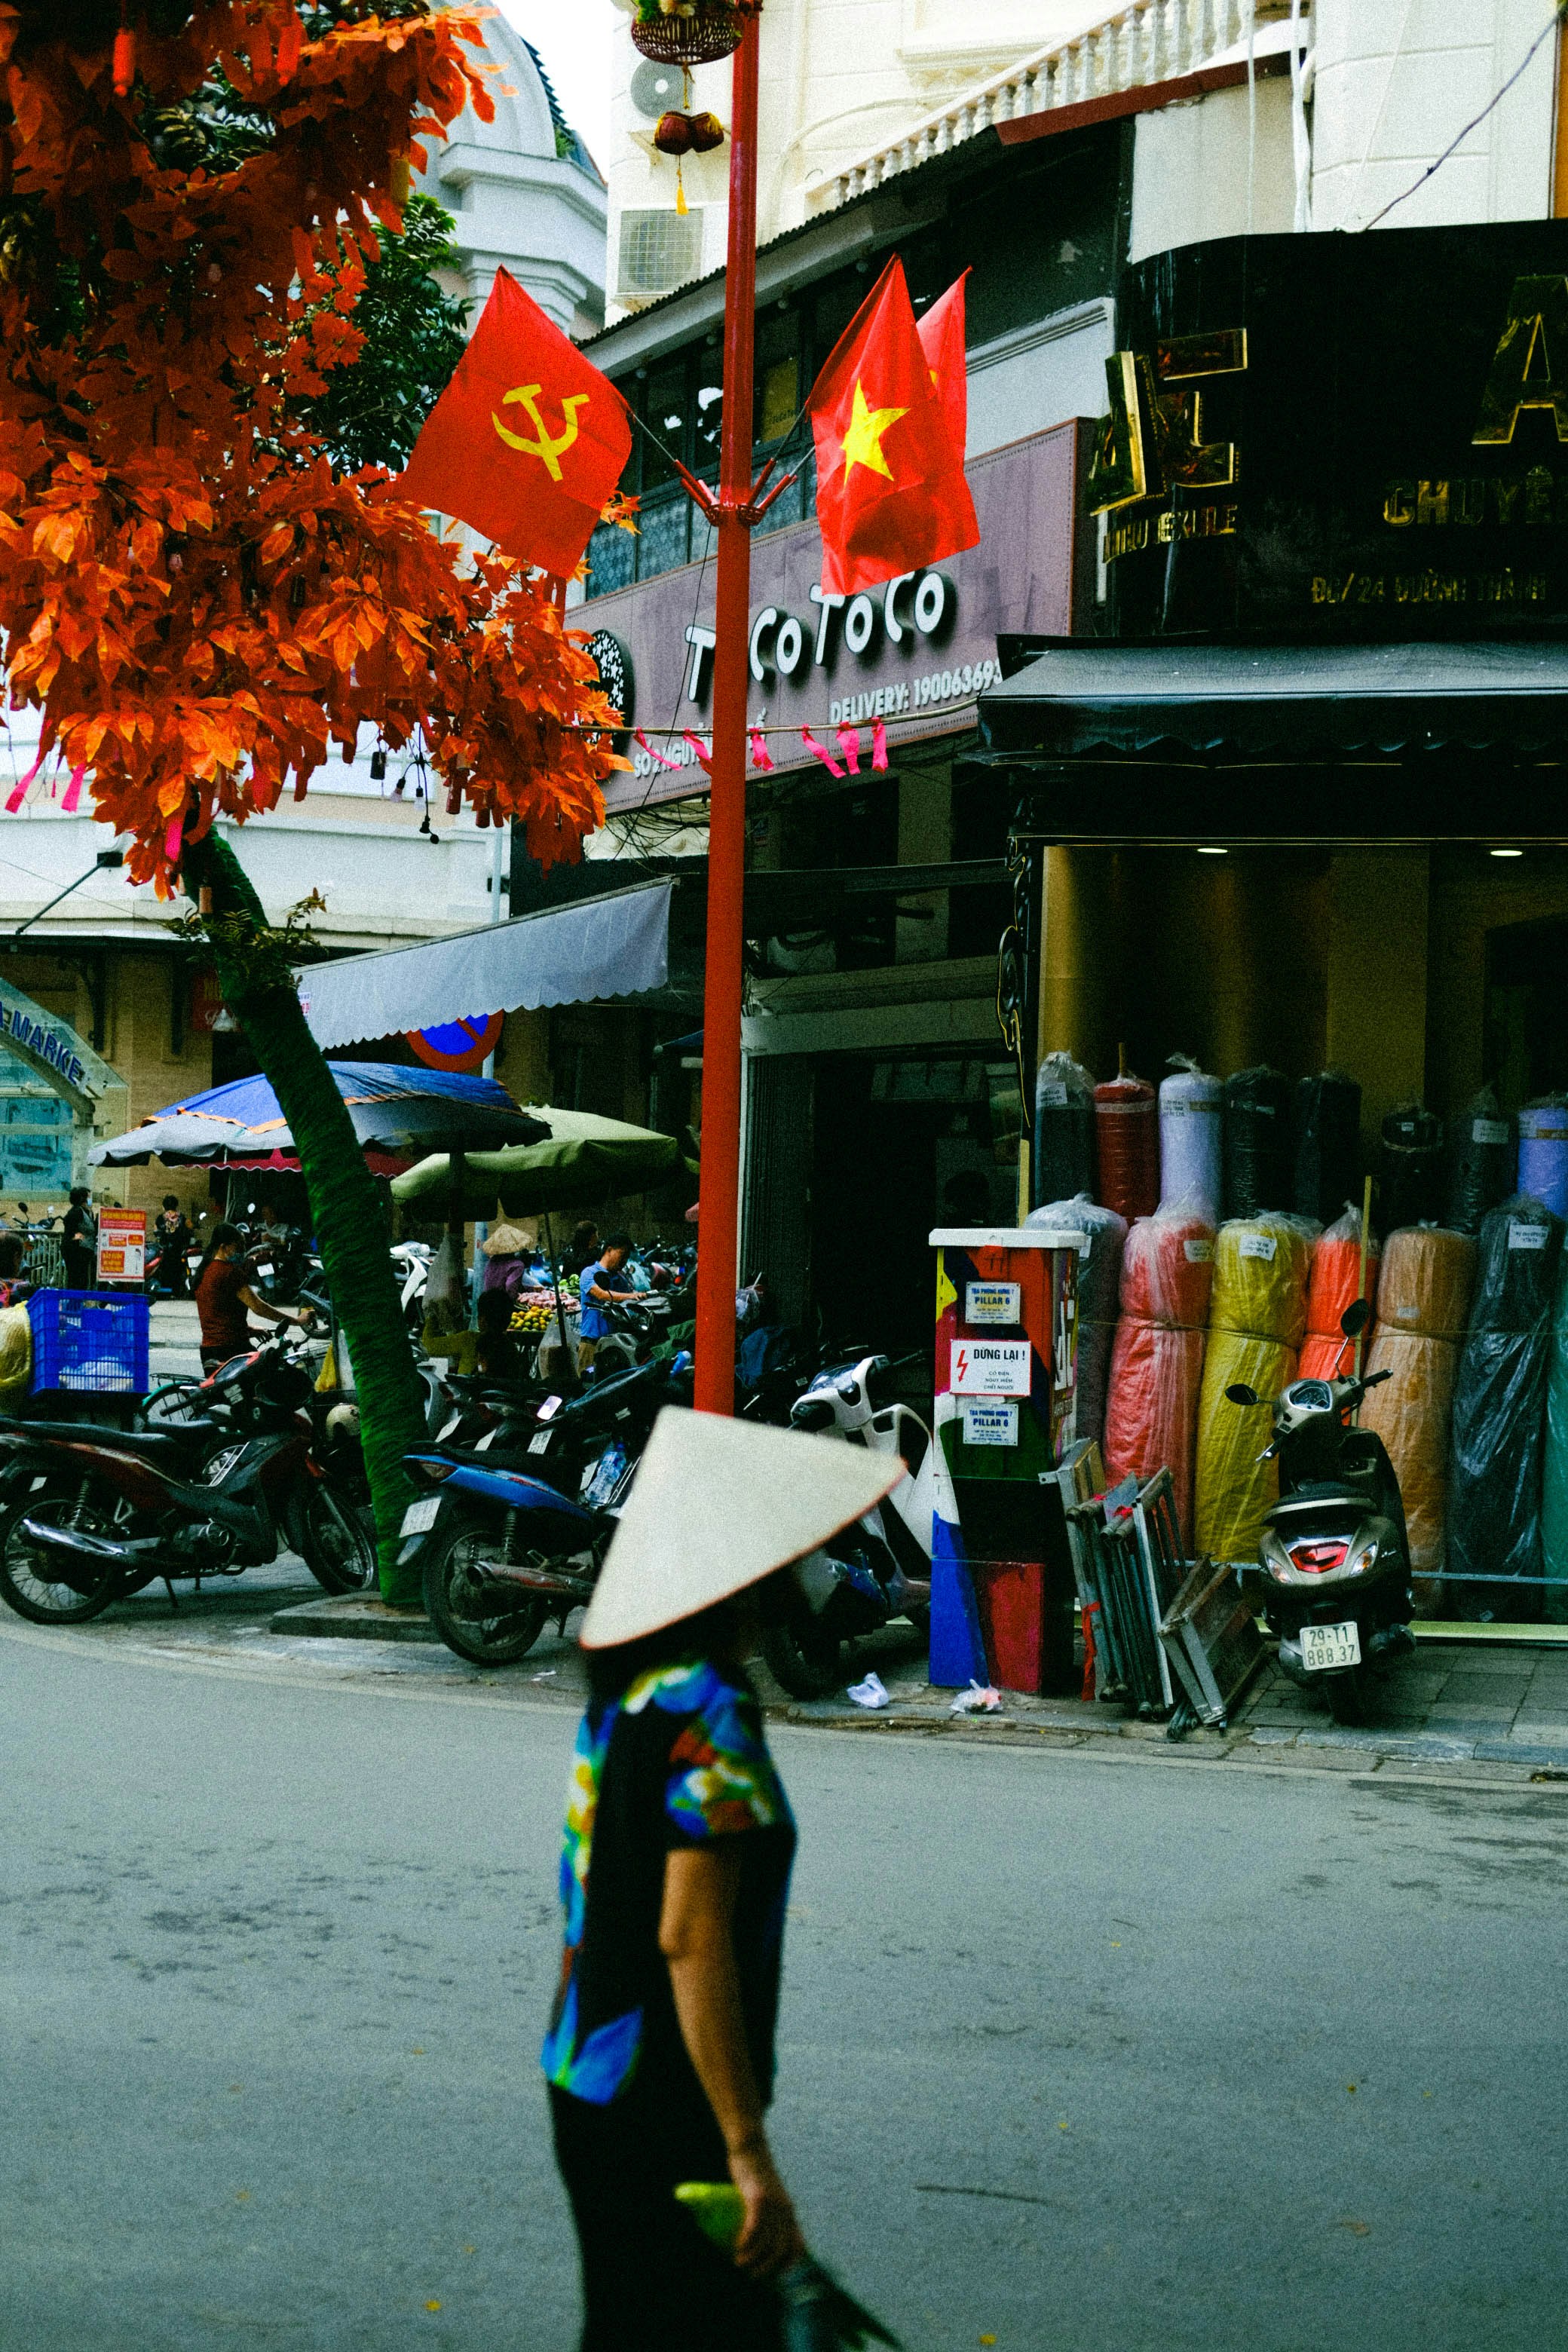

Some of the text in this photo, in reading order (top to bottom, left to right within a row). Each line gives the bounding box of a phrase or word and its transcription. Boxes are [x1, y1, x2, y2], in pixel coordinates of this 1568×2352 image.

[684, 571, 947, 703] TCOTOCO
[830, 682, 910, 726] DELIVERY:
[975, 1297, 1003, 1305] PILLAR
[973, 1346, 1001, 1360] DỪNG
[1003, 1349, 1018, 1363] LẠI
[973, 1418, 1001, 1426] PILLAR
[1309, 1625, 1349, 1647] 29-T1
[1306, 1644, 1355, 1666] 888.37
